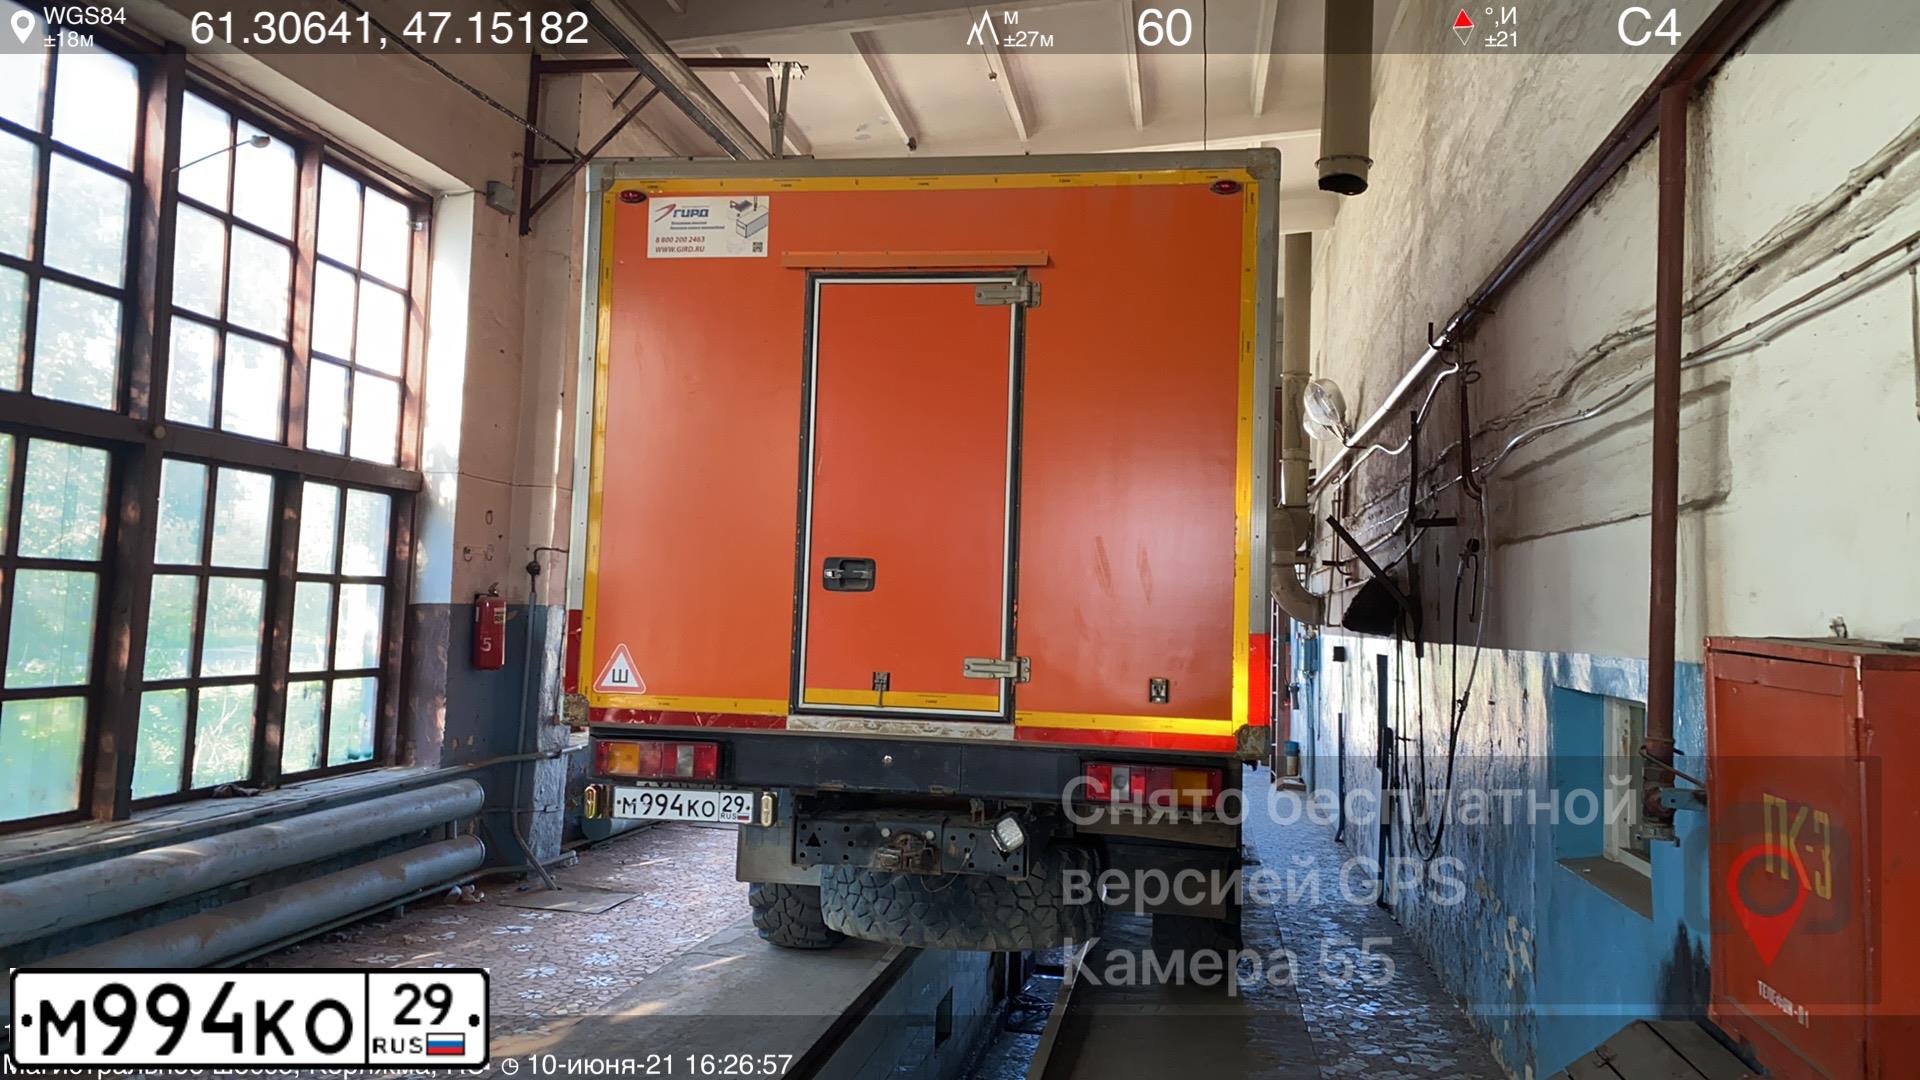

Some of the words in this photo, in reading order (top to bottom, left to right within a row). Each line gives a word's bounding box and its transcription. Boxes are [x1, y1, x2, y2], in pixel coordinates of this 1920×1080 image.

[480, 637, 492, 652] 5
[611, 668, 629, 684] Ш
[622, 792, 716, 818] М994КО
[722, 795, 745, 813] 29
